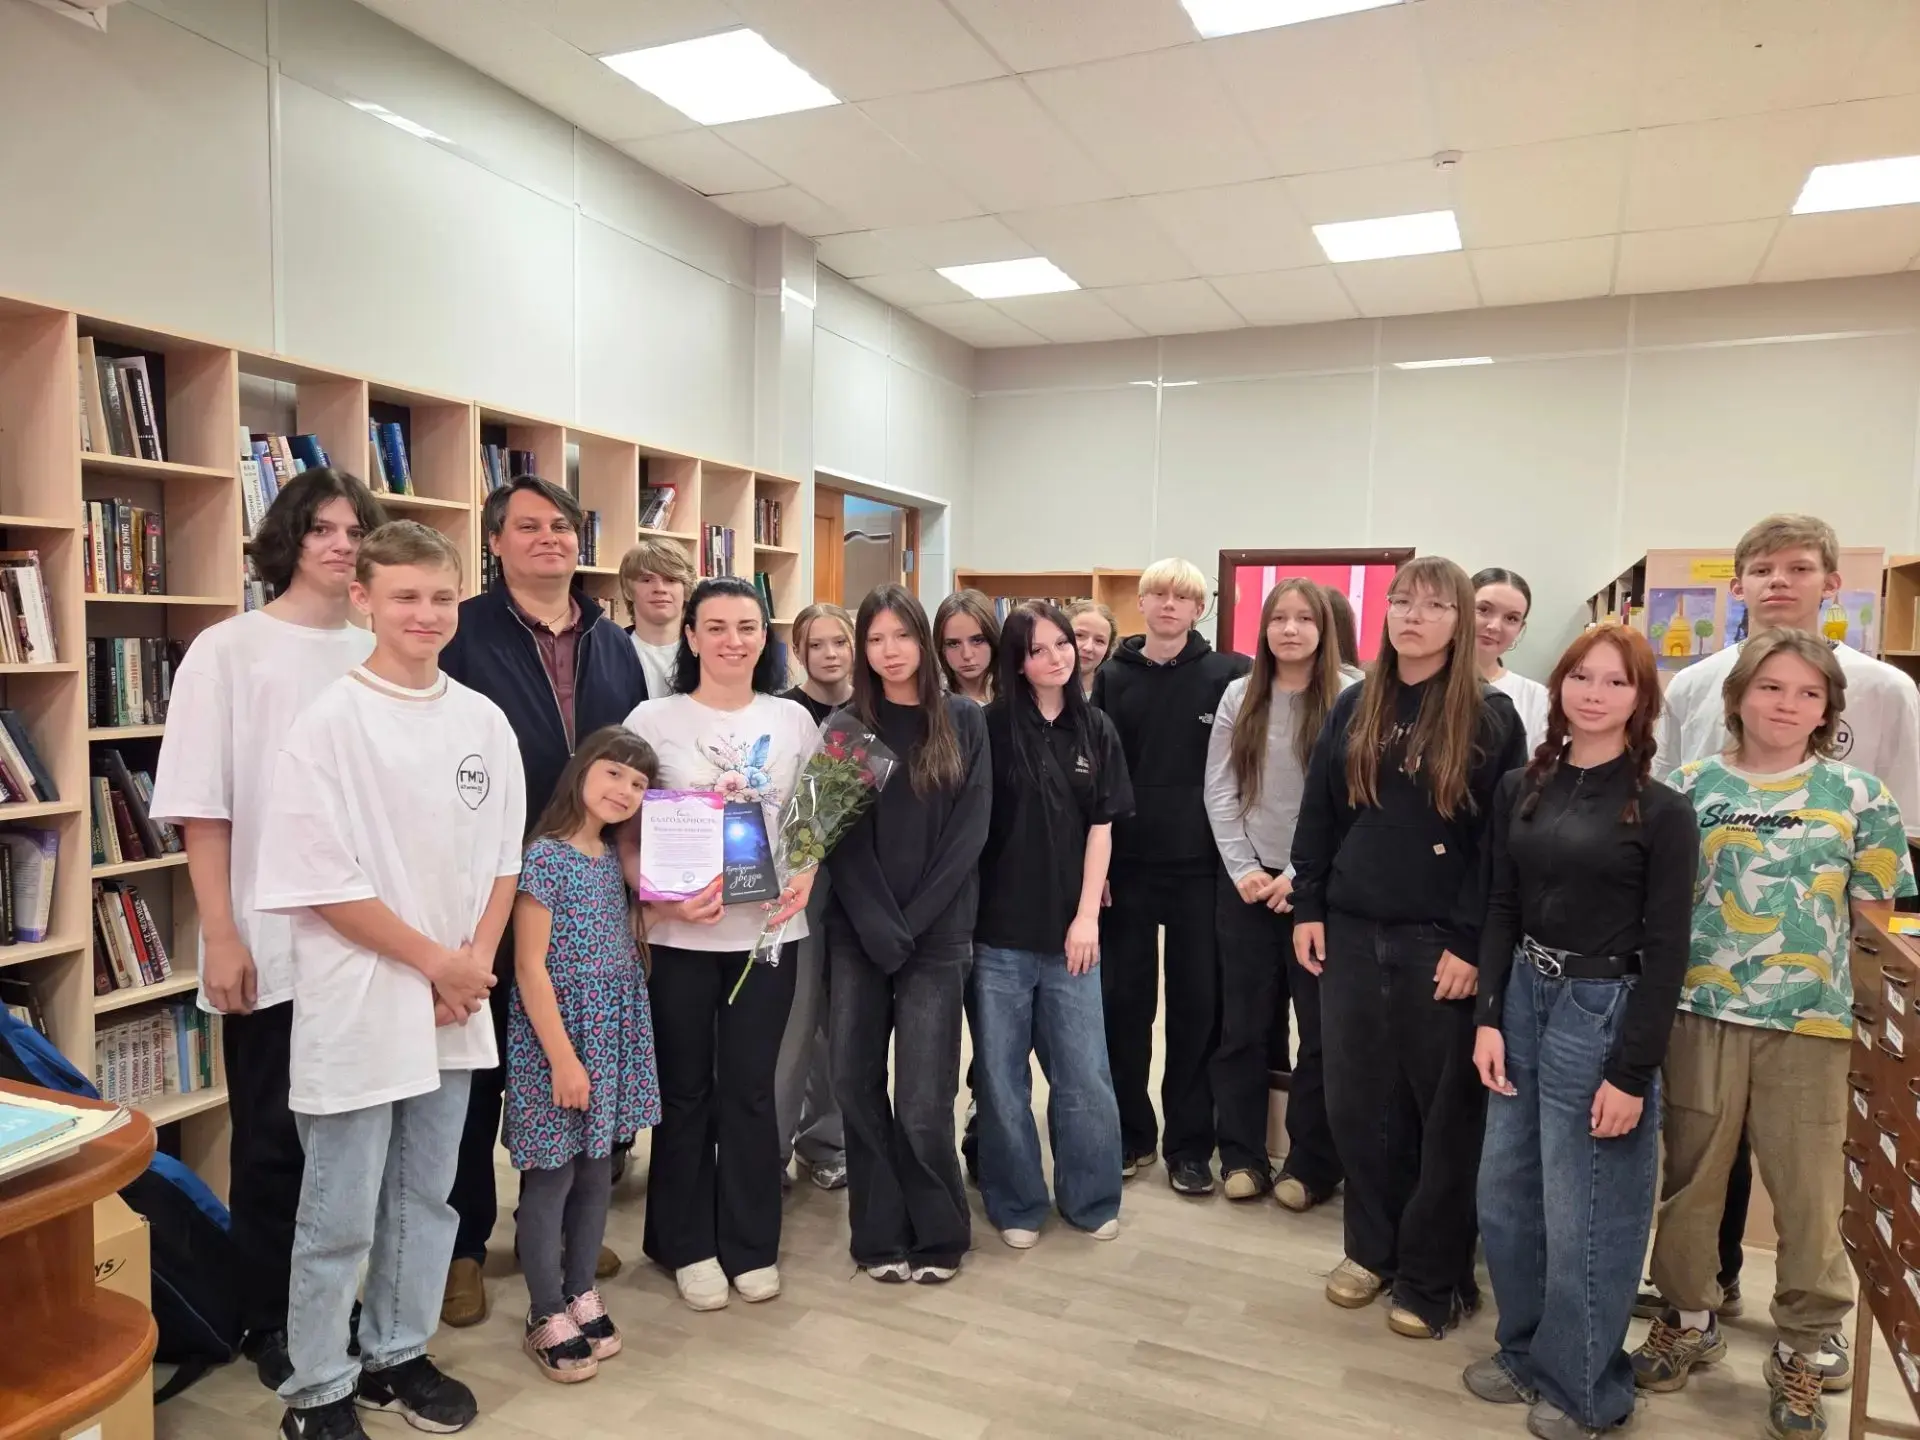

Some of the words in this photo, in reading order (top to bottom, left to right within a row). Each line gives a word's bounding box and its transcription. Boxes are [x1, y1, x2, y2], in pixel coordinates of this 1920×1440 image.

[247, 494, 257, 524] ИСТОРИЯ
[121, 523, 130, 545] КУНТС
[123, 546, 131, 571] СТИВЕН
[1700, 802, 1803, 829] Summer
[1725, 825, 1757, 833] BANANA
[729, 872, 763, 889] звезда
[118, 1042, 126, 1059] МИР
[141, 1040, 150, 1056] МИР
[119, 1061, 127, 1095] ПОЗНАЮ
[141, 1057, 150, 1088] ПОЗНАЮ
